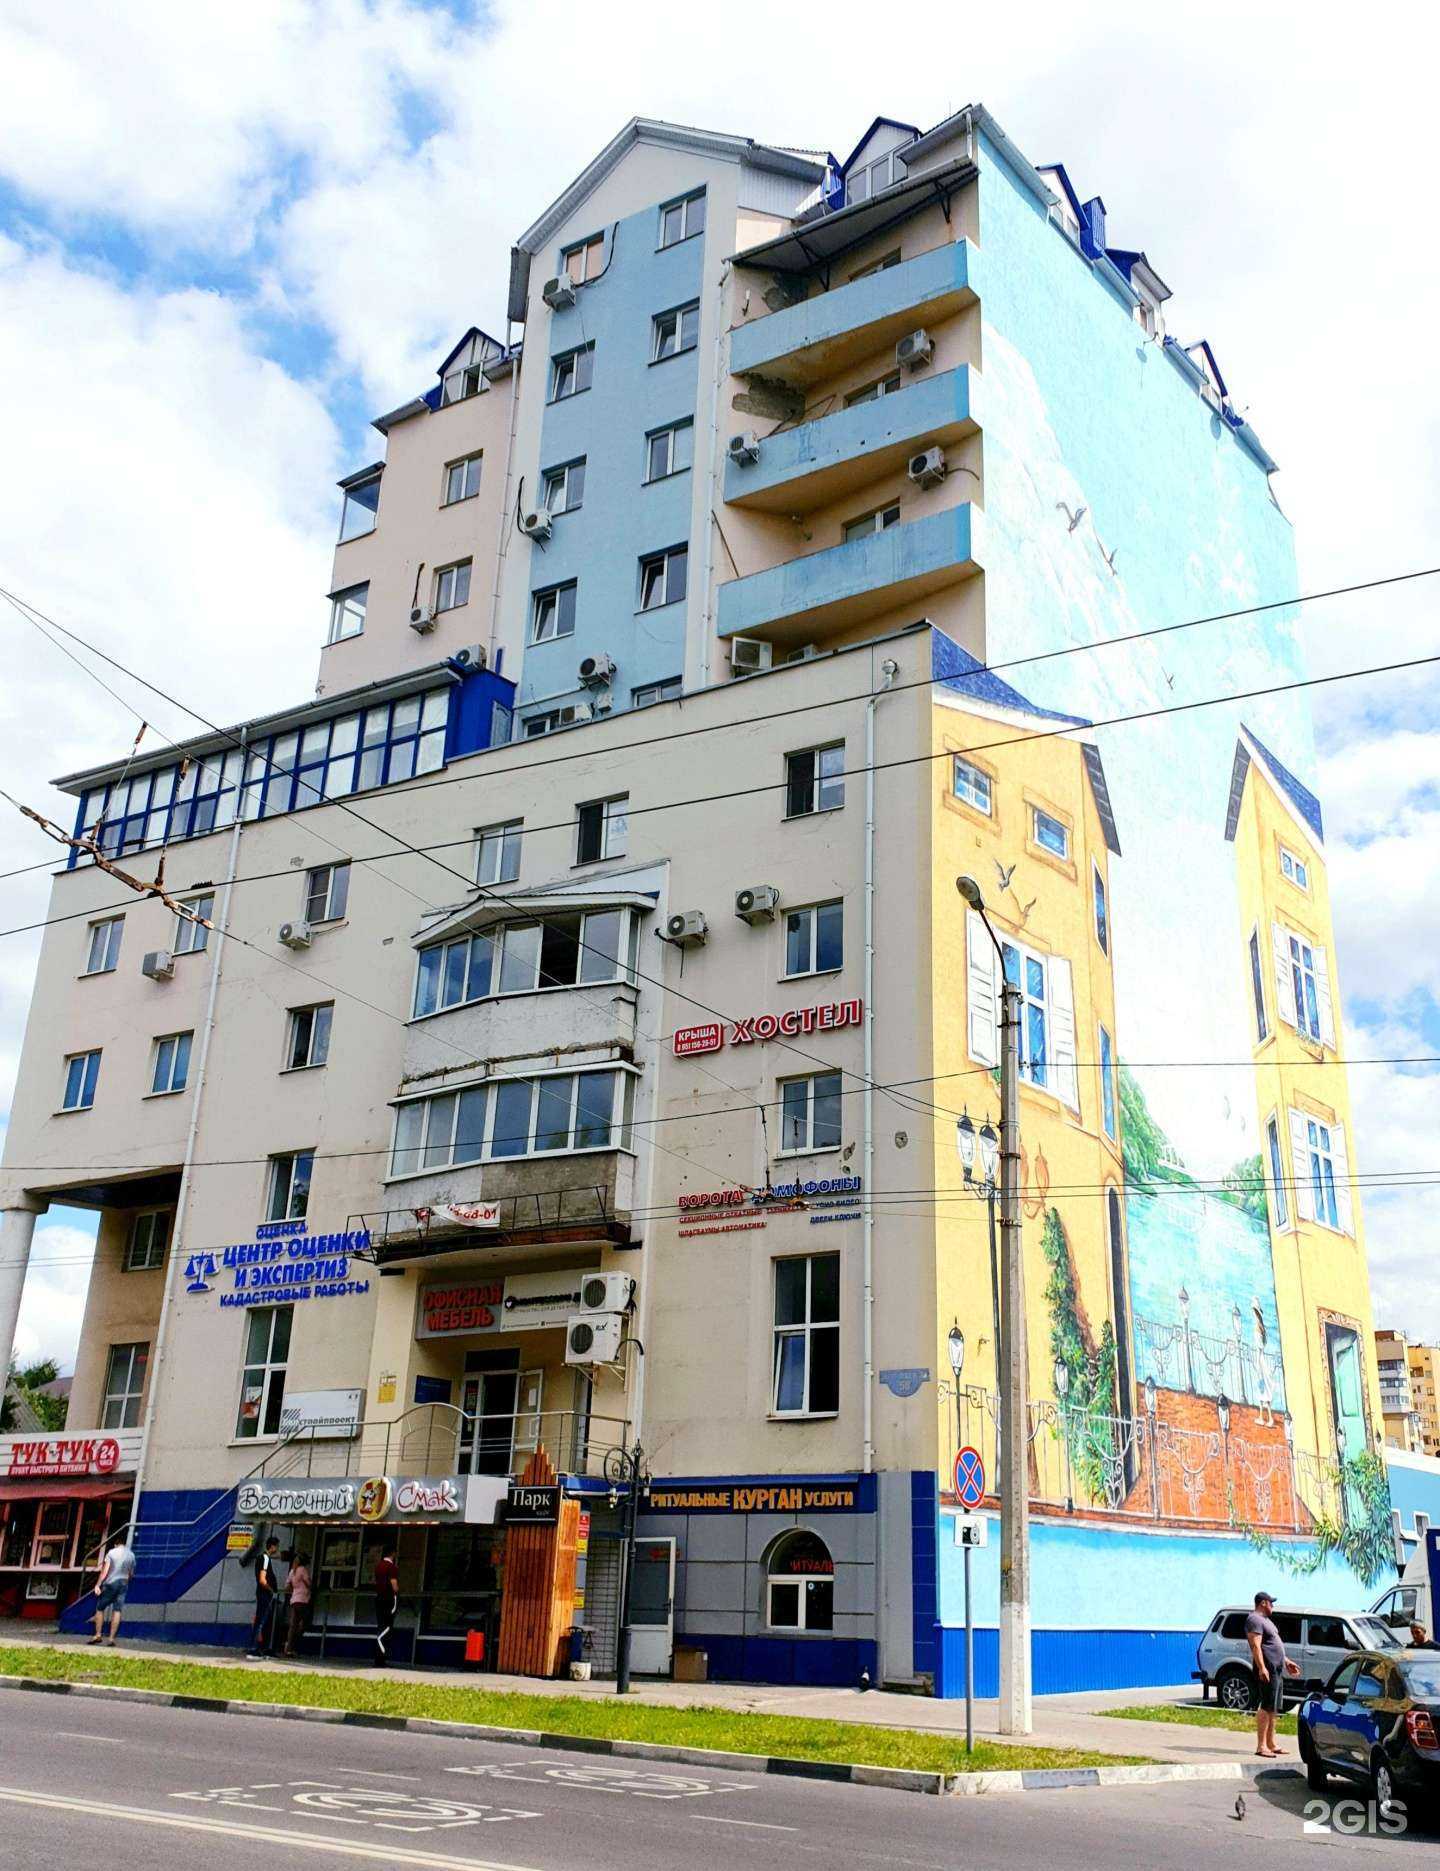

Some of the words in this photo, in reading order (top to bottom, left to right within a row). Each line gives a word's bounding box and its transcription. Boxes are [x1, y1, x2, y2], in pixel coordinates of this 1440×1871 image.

[678, 1027, 717, 1042] КРЫША
[730, 998, 863, 1045] ХОСТЕЛ
[678, 1190, 745, 1209] ВОРОТА
[256, 1222, 308, 1240] ОЦЕНКА
[223, 1242, 284, 1268] ЦЕНТР
[287, 1230, 371, 1259] ОЦЕНКИ
[235, 1267, 248, 1289] И
[250, 1257, 350, 1286] ЭКСПЕРТИЗ
[220, 1286, 311, 1308] КАДАСТРОВЫЕ
[314, 1279, 370, 1298] РАБОТЫ
[423, 1285, 502, 1311] ОФИСНАЯ
[427, 1306, 495, 1332] МЕБЕЛЬ
[11, 1440, 96, 1465] ТУК-ТУК
[101, 1446, 116, 1459] 24
[239, 1486, 351, 1512] Восточный
[397, 1481, 458, 1510] Смак
[512, 1489, 551, 1510] Парк
[650, 1492, 730, 1508] РИТУАЛЬНЫЕ
[733, 1488, 803, 1510] КУРГАН
[804, 1490, 854, 1506] УСЛУГИ
